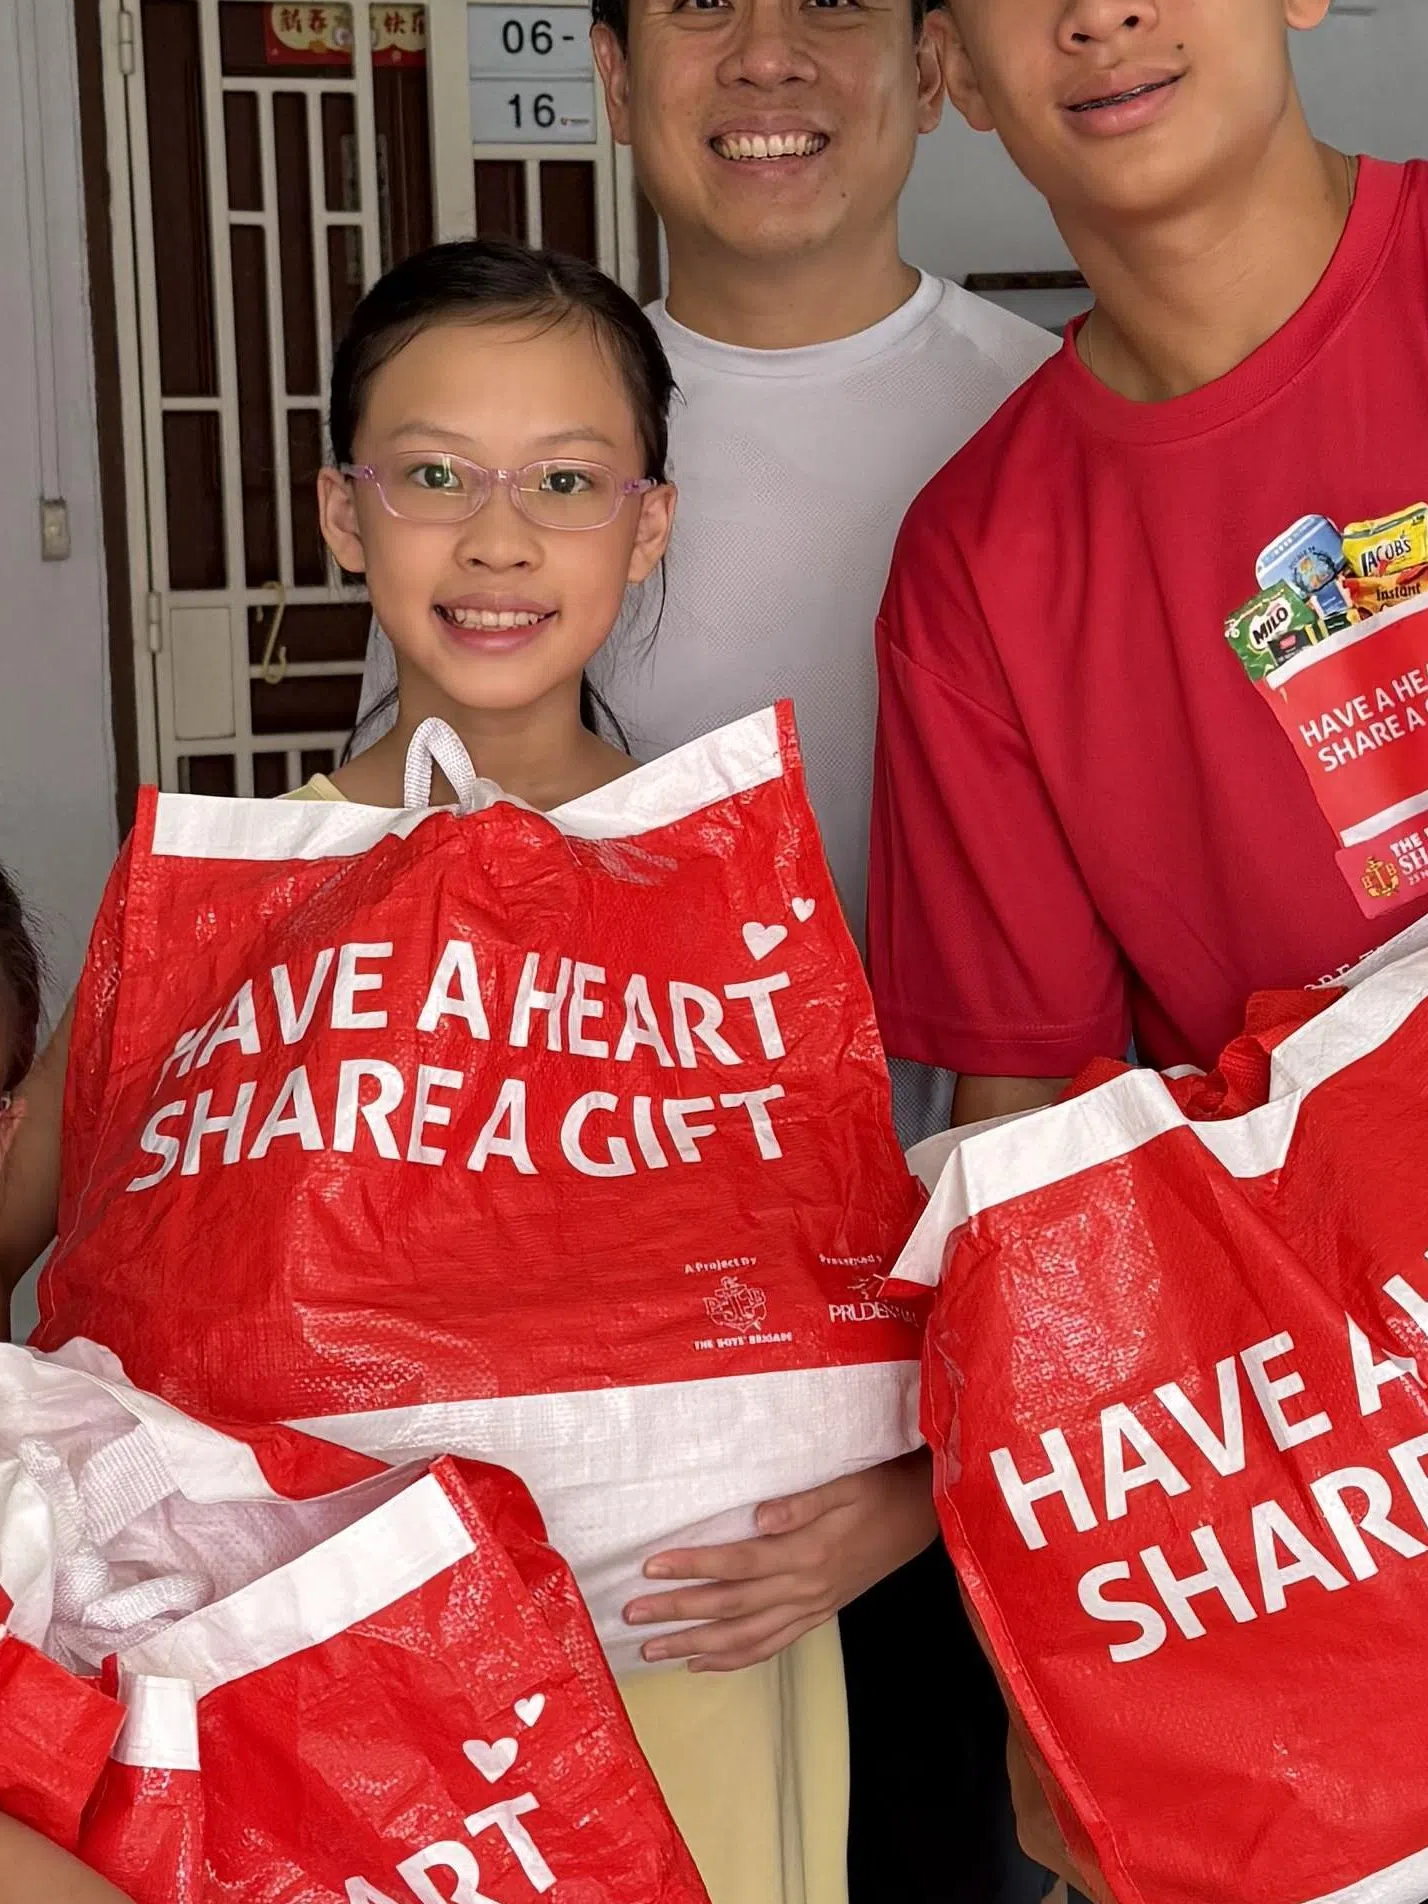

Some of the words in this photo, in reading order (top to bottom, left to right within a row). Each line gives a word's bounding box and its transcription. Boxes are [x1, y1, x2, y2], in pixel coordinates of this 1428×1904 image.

[508, 93, 556, 128] 16
[1376, 583, 1421, 601] Instant
[1252, 606, 1289, 645] MILO
[1299, 696, 1374, 747] HAVE
[1375, 687, 1395, 712] A
[1317, 714, 1406, 773] SHARE
[1406, 706, 1426, 731] A
[1390, 832, 1422, 857] THE
[152, 941, 393, 1097] HAVE
[416, 940, 491, 1040] A
[510, 951, 789, 1069] HEART
[125, 1059, 461, 1193] SHARE
[468, 1079, 538, 1176] A
[560, 1084, 785, 1178] GIFT
[991, 1332, 1331, 1551] HAVE
[1345, 1312, 1426, 1416] A
